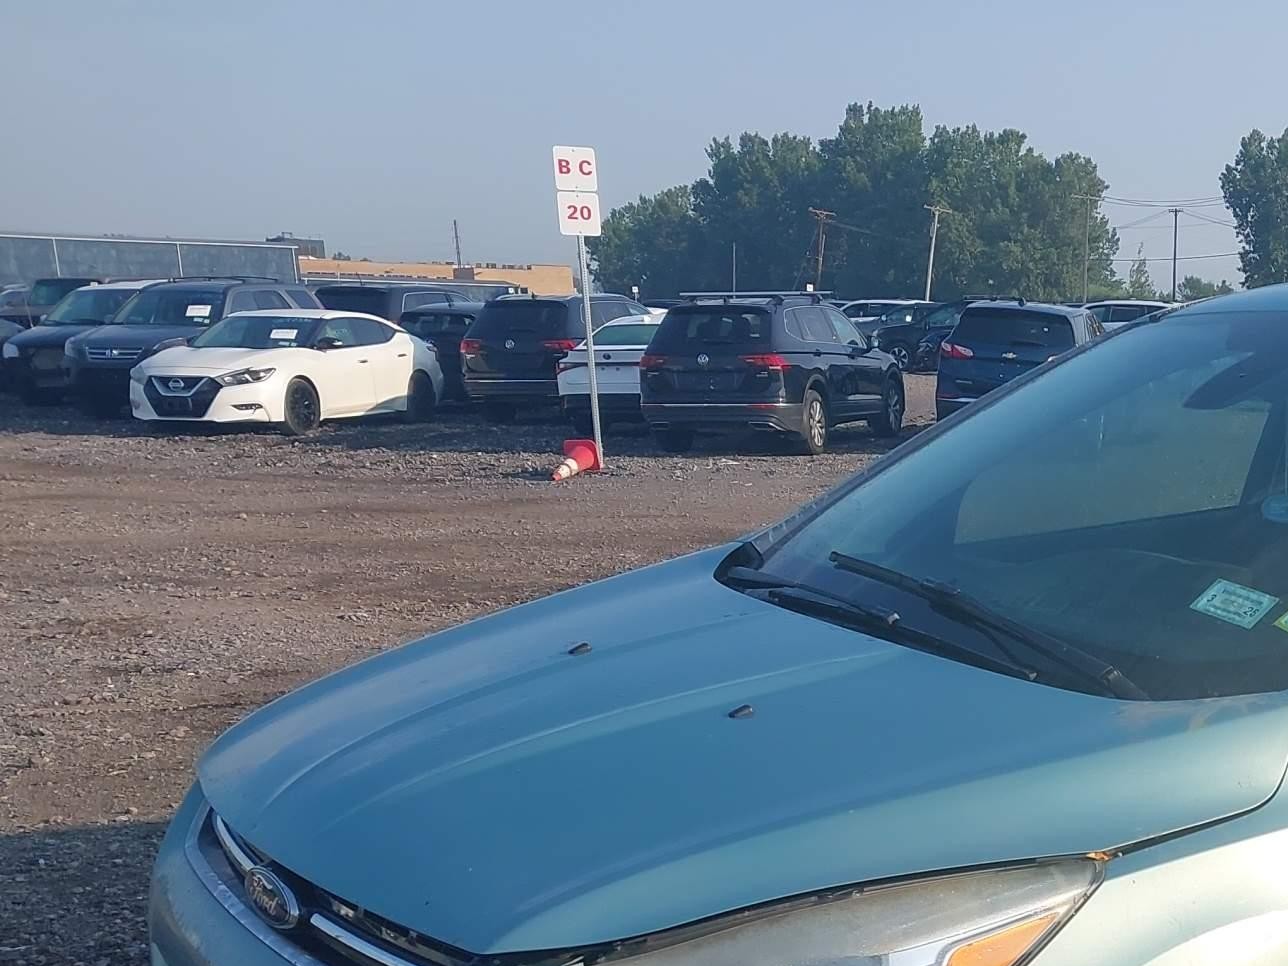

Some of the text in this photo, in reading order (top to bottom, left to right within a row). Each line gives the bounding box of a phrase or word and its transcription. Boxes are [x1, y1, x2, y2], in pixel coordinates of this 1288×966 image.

[557, 158, 593, 176] B C
[567, 204, 592, 221] 20
[249, 874, 279, 917] Ford
